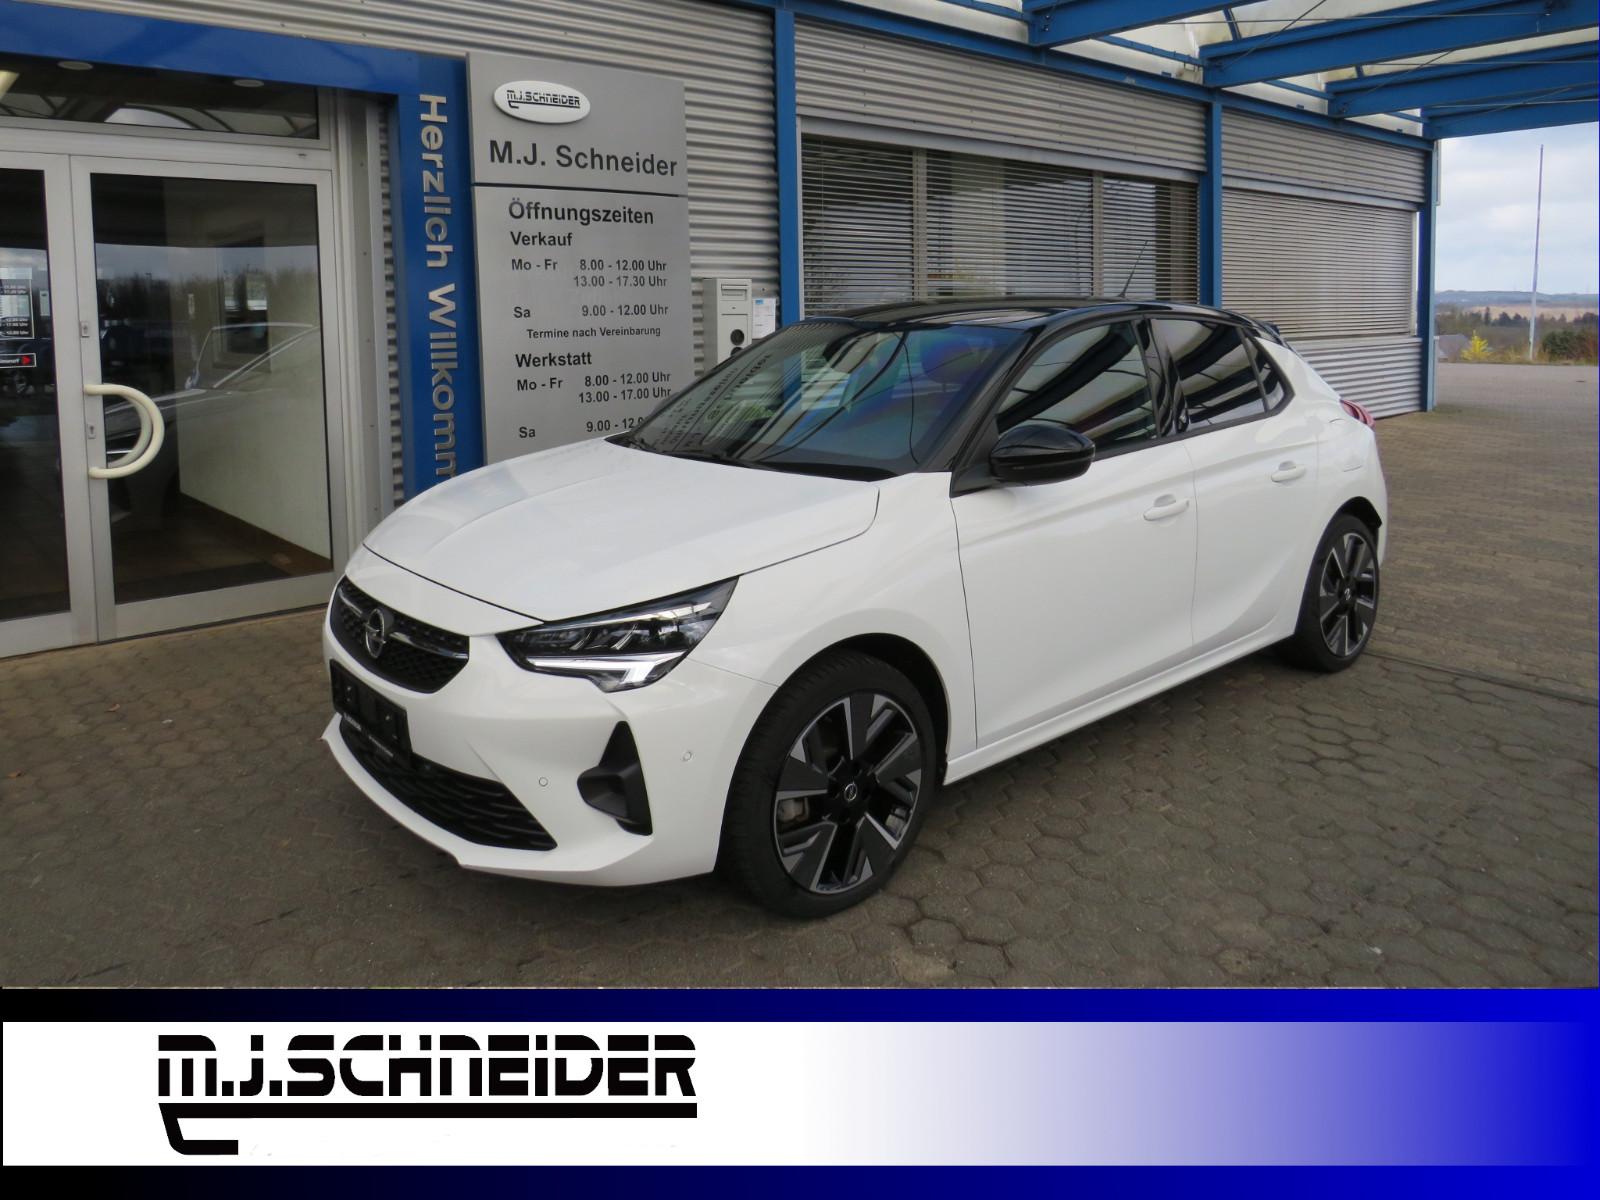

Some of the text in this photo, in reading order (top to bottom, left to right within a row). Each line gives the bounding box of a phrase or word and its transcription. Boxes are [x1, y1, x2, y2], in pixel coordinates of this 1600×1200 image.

[489, 140, 678, 176] M.J. Schneider
[508, 198, 654, 225] Öffnungszeiten
[510, 231, 573, 247] Verkauf
[511, 259, 532, 271] Mo
[544, 259, 558, 271] Fr
[579, 259, 604, 271] 8.00
[616, 259, 645, 271] 12.00
[648, 259, 667, 271] Uhr
[419, 94, 458, 477] Herzlich Willkomm
[574, 276, 605, 287] 13.00
[616, 276, 646, 287] 17.30
[648, 276, 667, 287] Uhr
[513, 306, 531, 319] Sa
[581, 305, 607, 317] 9.00
[617, 305, 647, 316] 12.00
[649, 304, 669, 316] Uhr
[527, 326, 661, 339] Termine nach Vereinbarung
[515, 351, 593, 368] Werkstatt
[516, 379, 537, 392] Mo
[549, 378, 563, 389] Fr
[584, 375, 610, 387] 8.00
[620, 372, 649, 385] 12.00
[652, 371, 671, 383] Uhr
[578, 391, 610, 404] 13.00
[620, 388, 650, 401] 17.00
[652, 387, 671, 399] Uhr
[518, 426, 536, 439] Sa
[586, 420, 611, 433] 9.00
